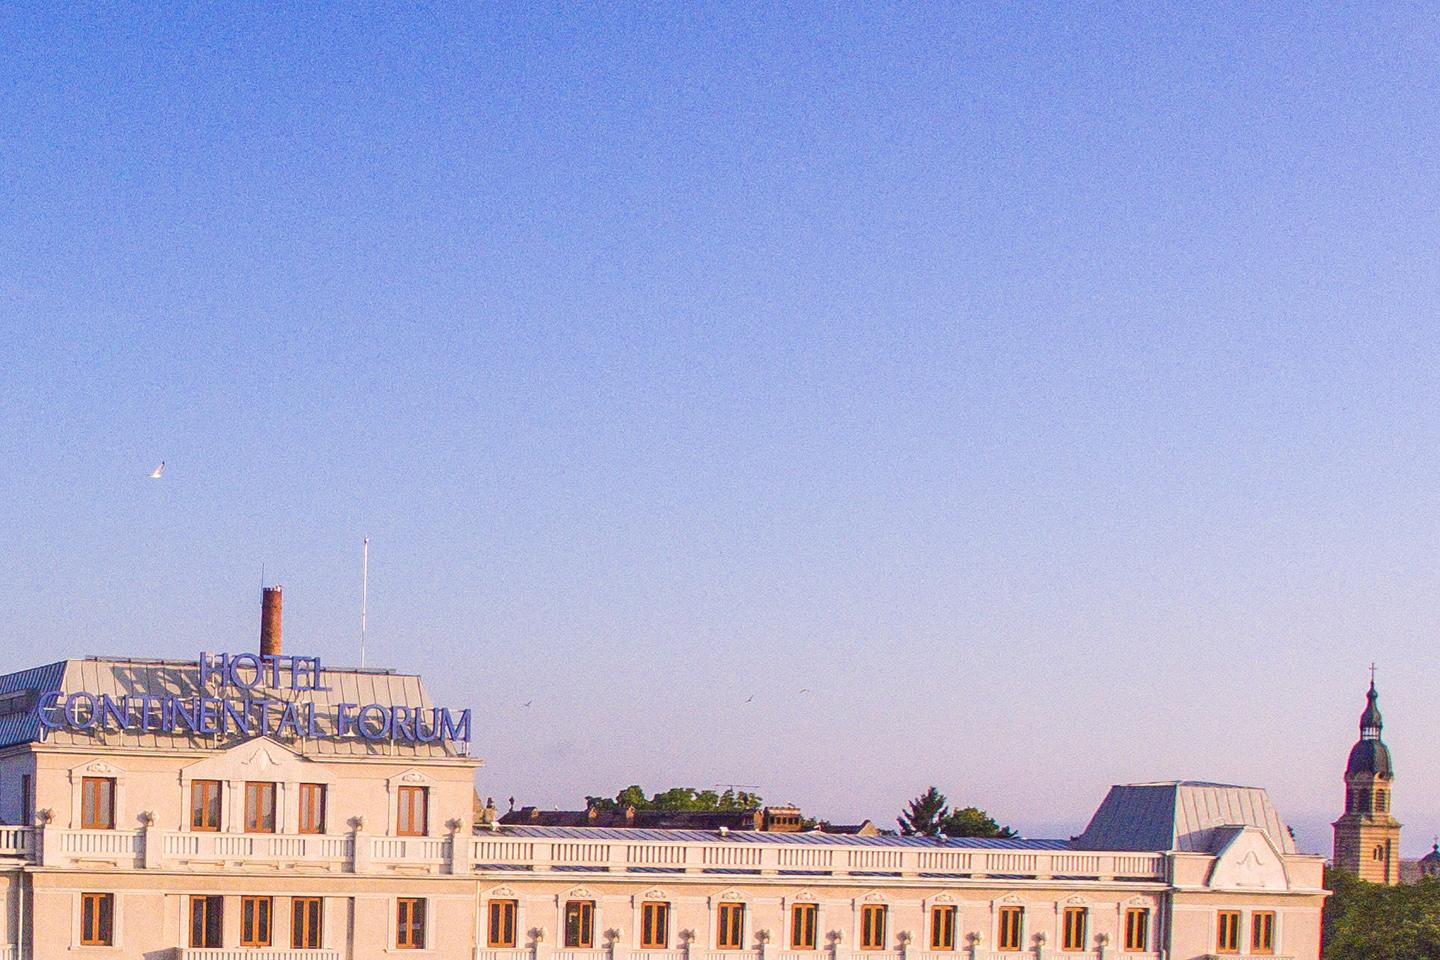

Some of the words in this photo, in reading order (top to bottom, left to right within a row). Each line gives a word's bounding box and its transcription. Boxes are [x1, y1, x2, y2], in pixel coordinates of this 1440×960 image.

[200, 651, 332, 691] HOTEL
[38, 691, 327, 738] CONTINENTAL
[338, 702, 472, 743] FORUM
